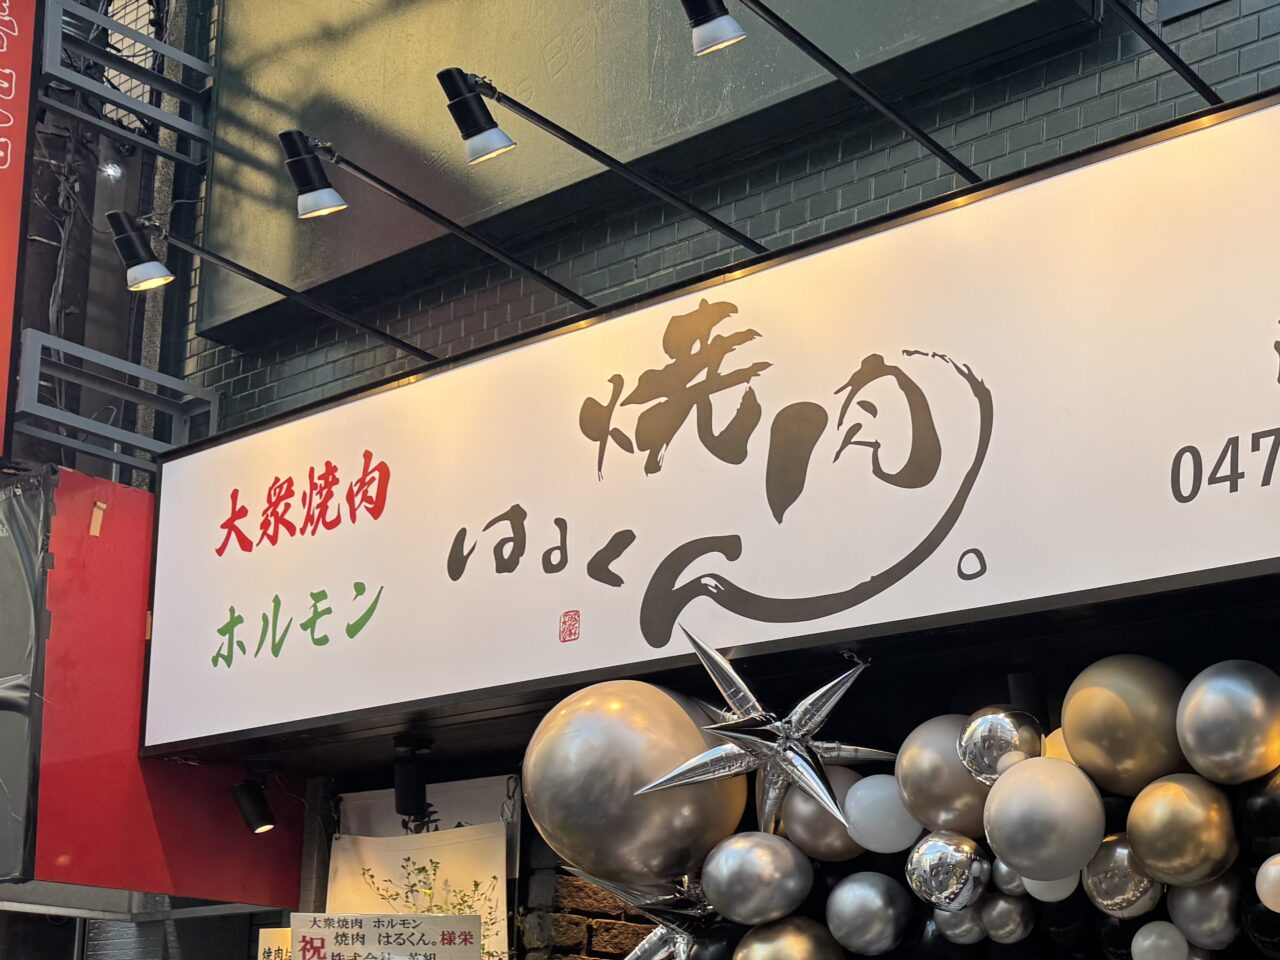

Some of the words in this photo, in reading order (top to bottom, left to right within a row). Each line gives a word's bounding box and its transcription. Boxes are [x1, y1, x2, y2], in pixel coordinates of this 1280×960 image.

[579, 298, 941, 524] 焼肉
[215, 450, 390, 557] 大衆焼肉
[212, 582, 384, 668] ホルモン
[300, 935, 327, 960] 祝
[309, 918, 363, 929] 大衆焼肉
[373, 918, 423, 928] ホルモン
[335, 932, 365, 945] 焼肉
[378, 933, 437, 946] はるくん。
